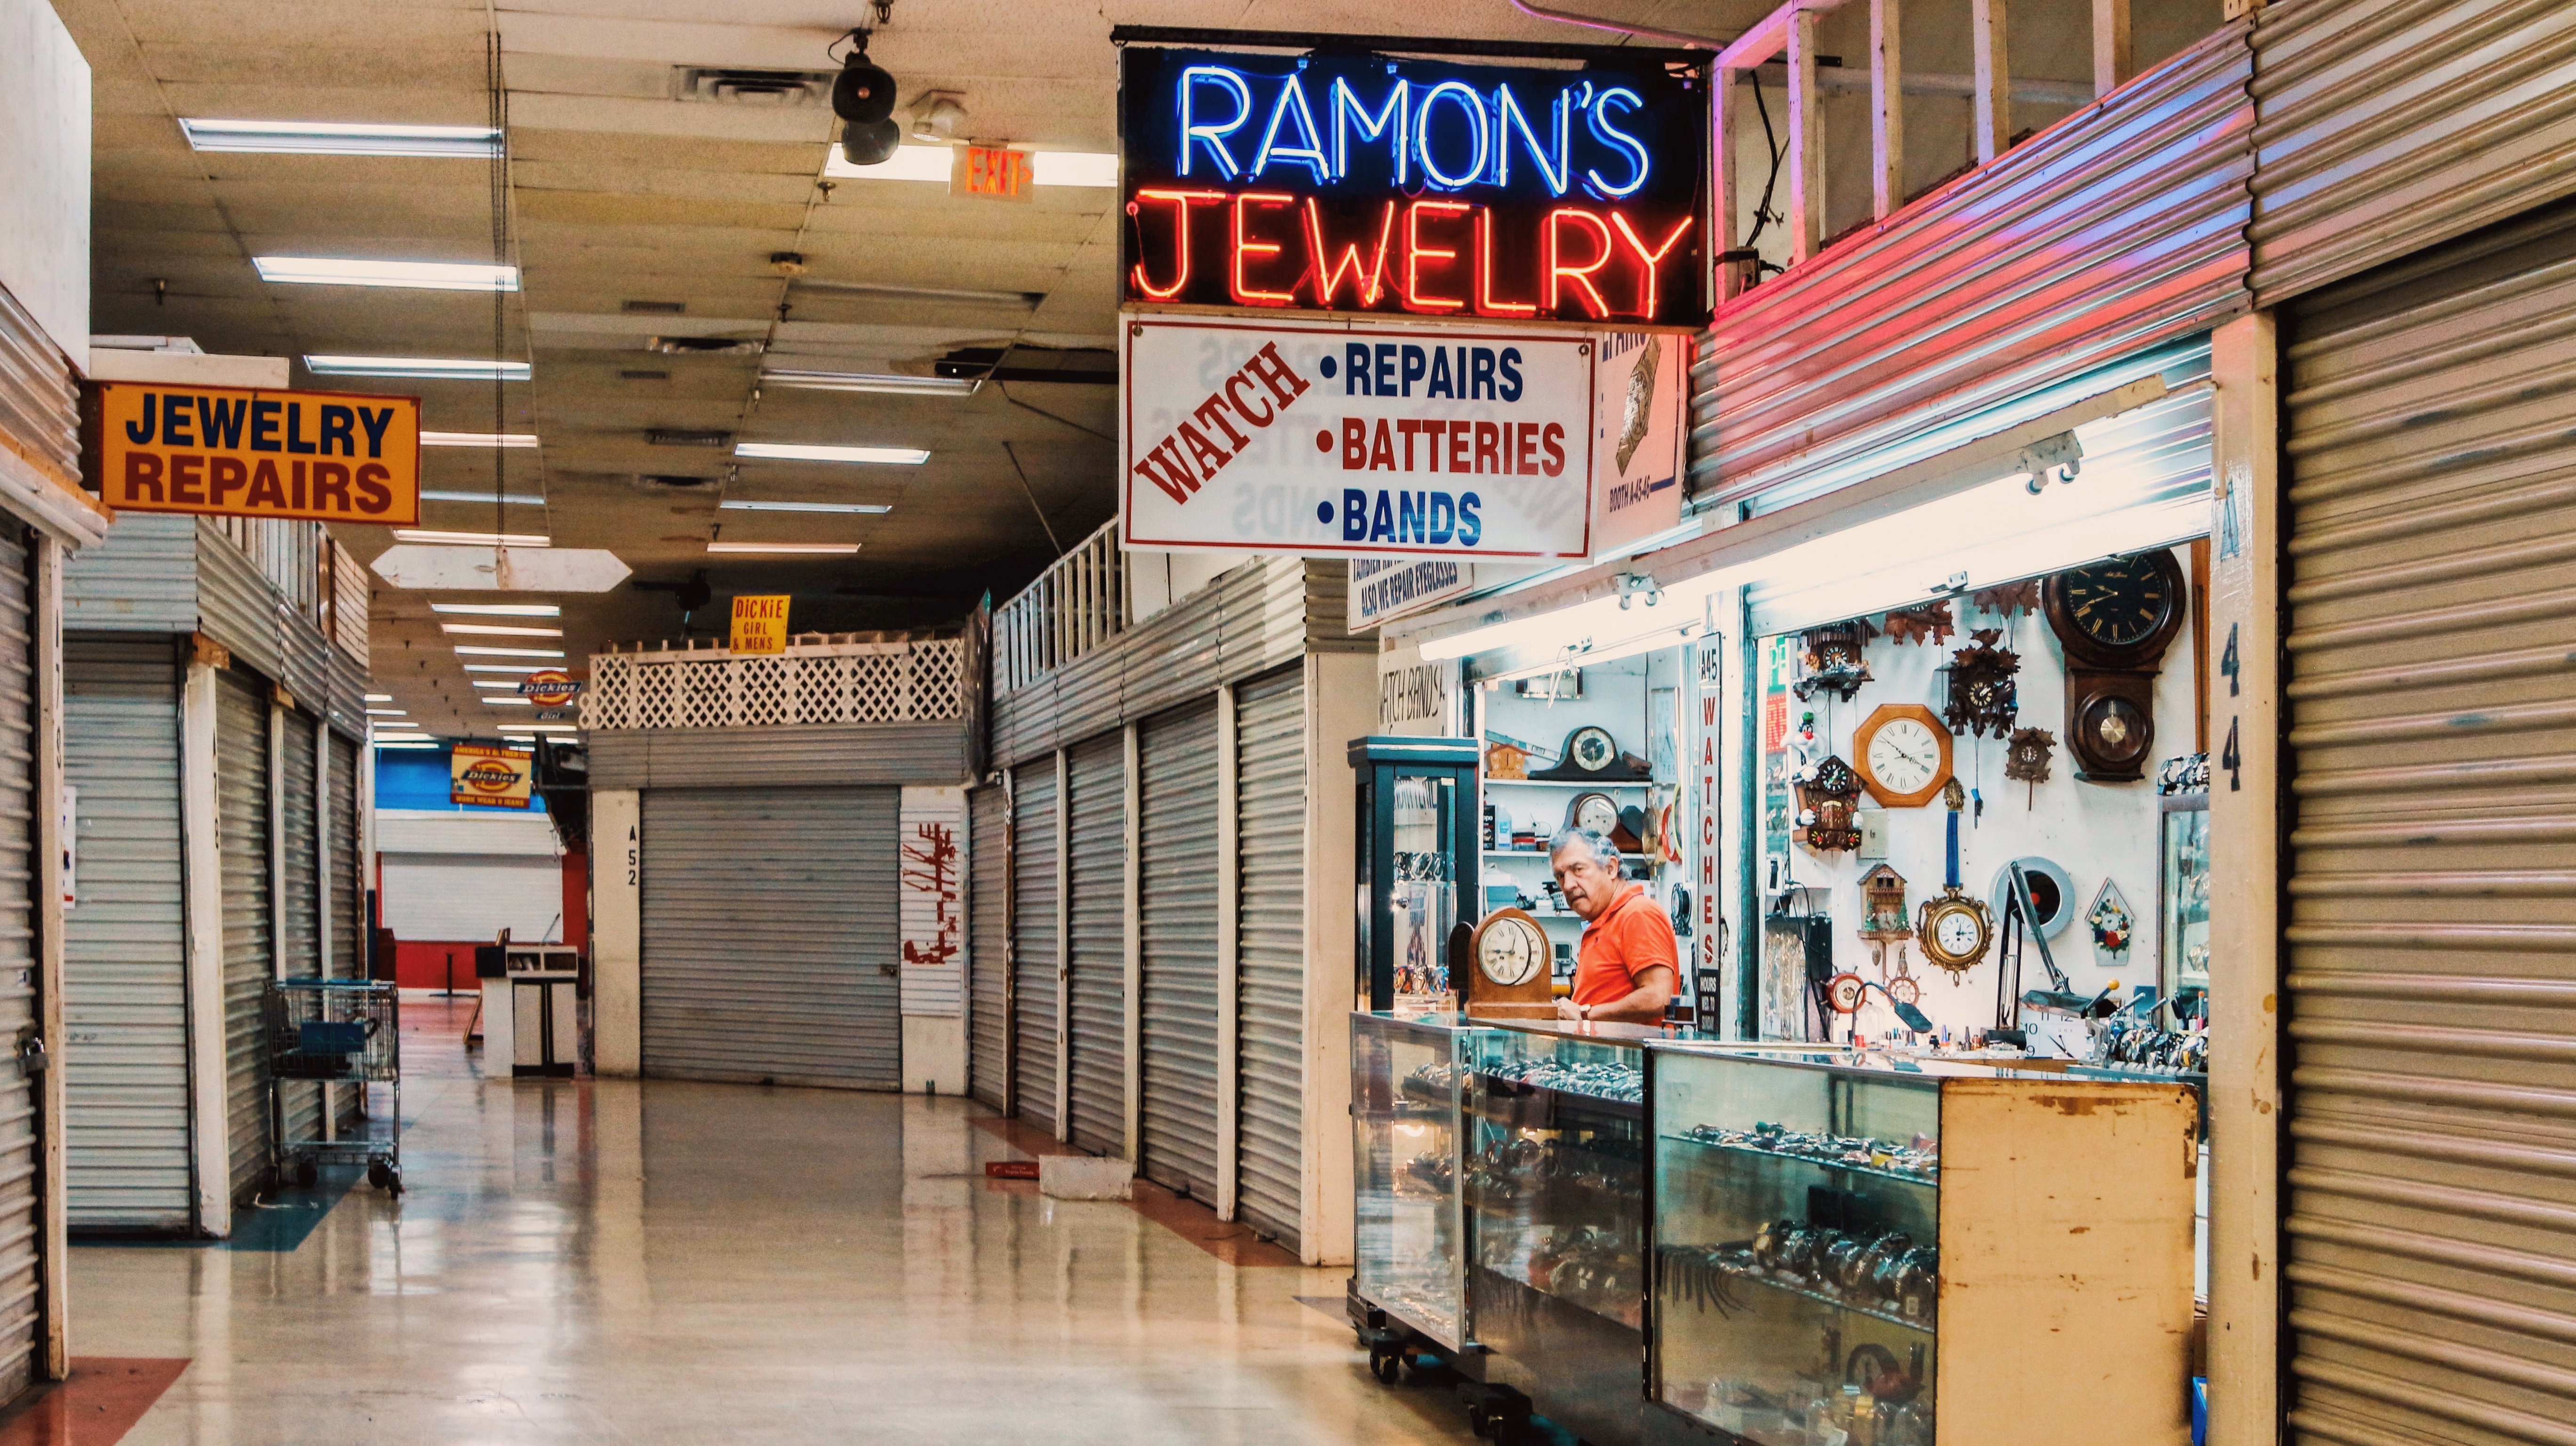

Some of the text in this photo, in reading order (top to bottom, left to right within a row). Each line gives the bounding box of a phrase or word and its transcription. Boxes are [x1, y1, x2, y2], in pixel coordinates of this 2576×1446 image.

[1178, 65, 1650, 198] RAMON'S
[966, 147, 1024, 196] EXIT
[1128, 189, 1693, 319] JEWELRY
[1345, 342, 1524, 402] REPAIRS
[126, 393, 395, 458] JEWELRY
[1134, 340, 1311, 506] WATCH
[1342, 417, 1566, 477] BATTERIES
[125, 451, 392, 514] REPAIRS
[1610, 483, 1629, 513] BOOTH
[1343, 488, 1482, 546] BANDS
[1362, 561, 1458, 618] ALSO WE REPAIR EYEGLASSES
[744, 621, 767, 635] GIRL
[745, 637, 773, 650] MENS
[523, 683, 576, 693] Dickies
[1407, 664, 1439, 721] BANDS
[467, 770, 516, 783] Dickies
[1703, 697, 1716, 964] WATCHES
[1700, 976, 1717, 992] HOURS
